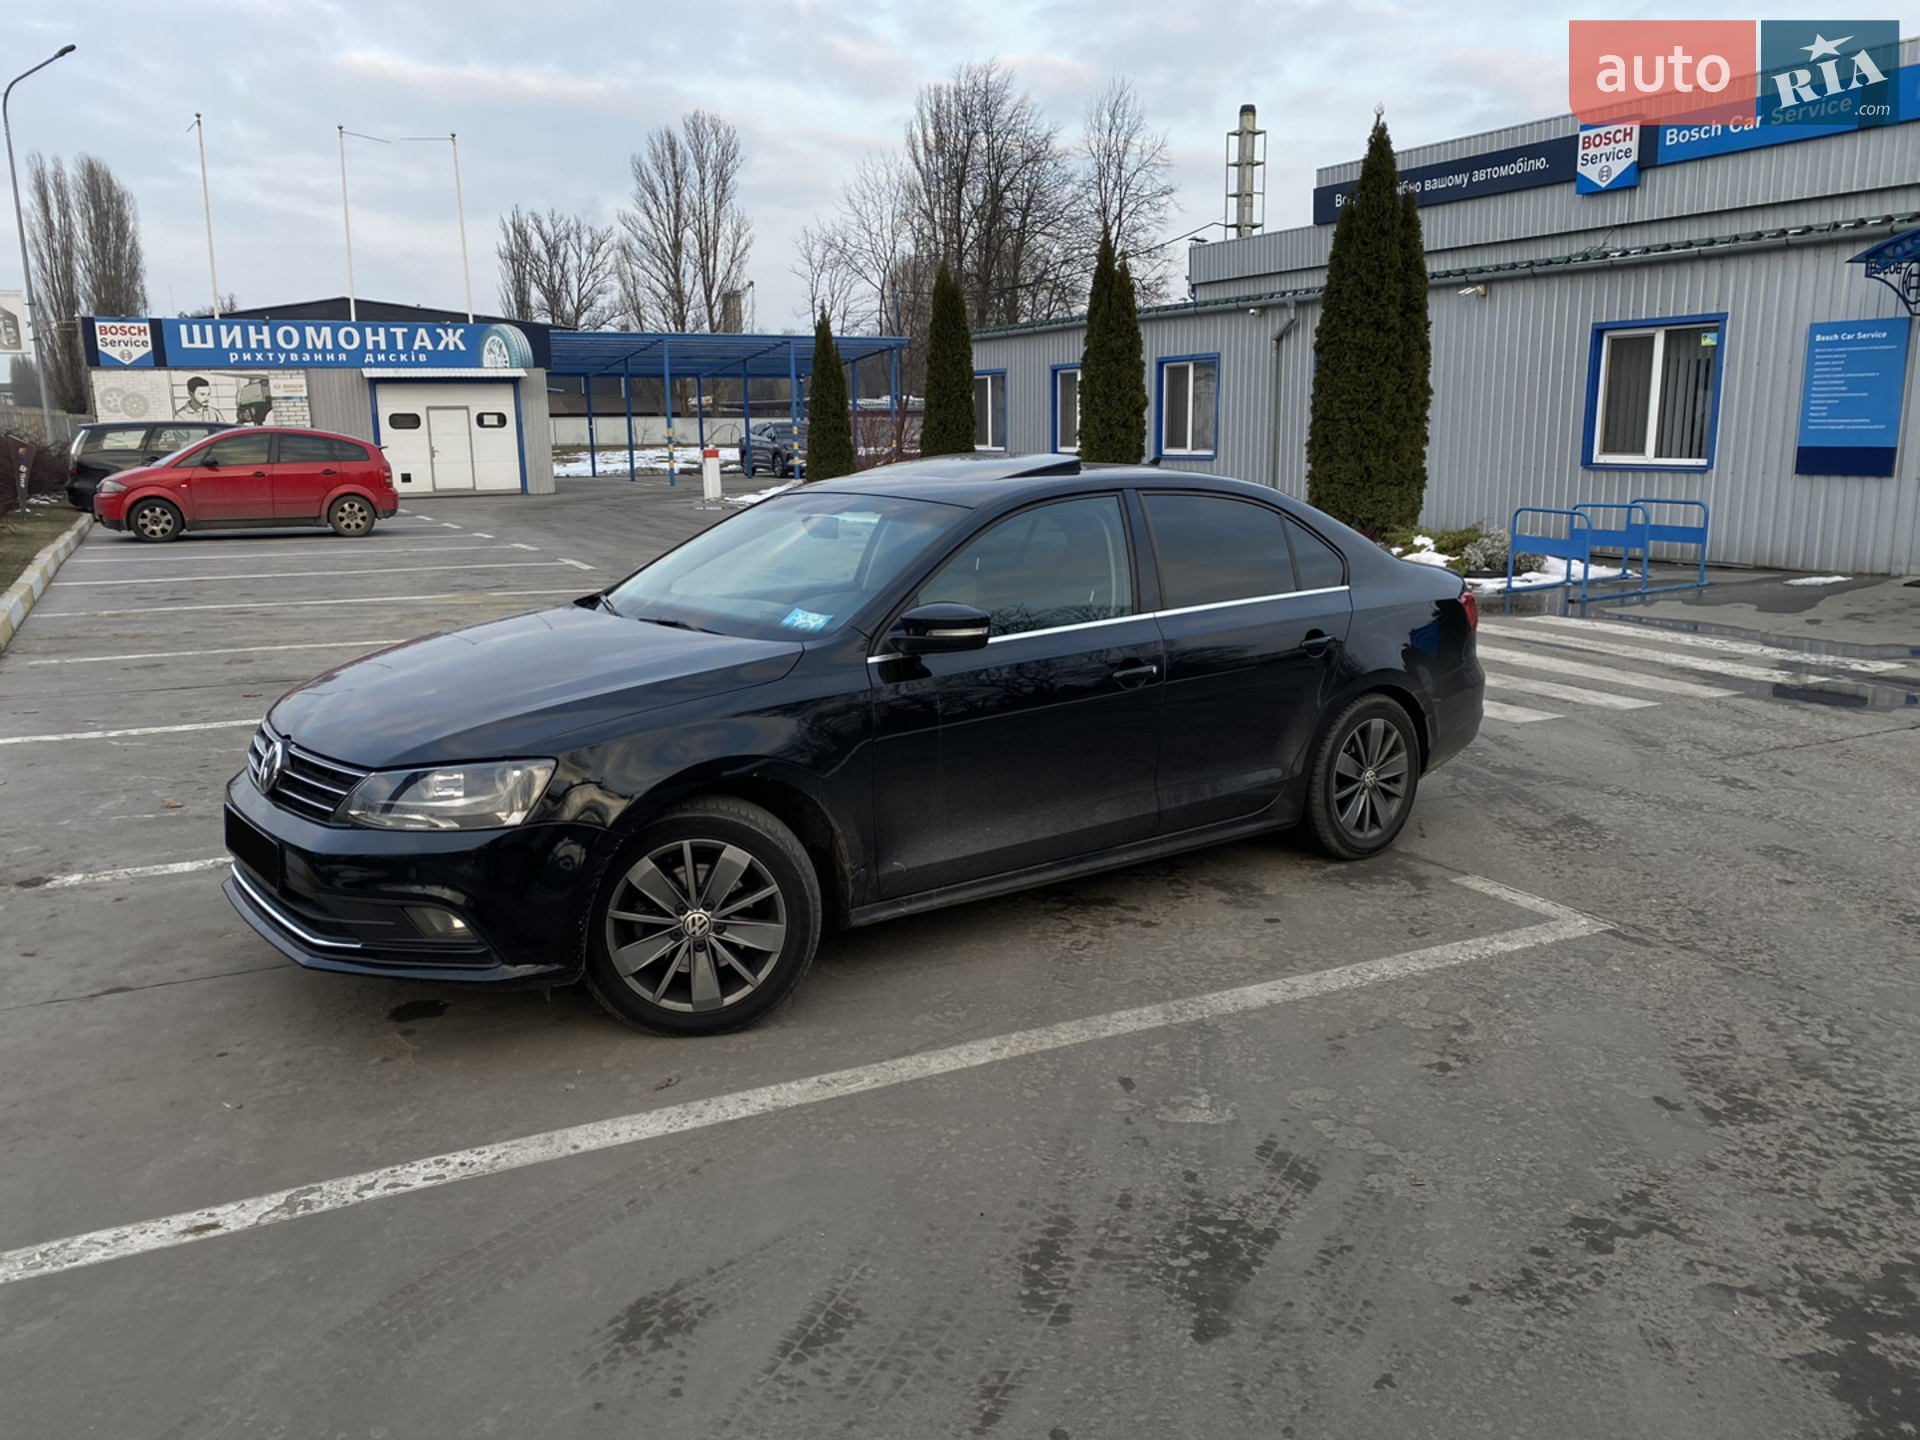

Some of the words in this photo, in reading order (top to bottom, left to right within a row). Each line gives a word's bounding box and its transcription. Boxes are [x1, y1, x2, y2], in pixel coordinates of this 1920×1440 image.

[1665, 118, 1722, 146] Bosch
[1729, 112, 1764, 133] Car
[1770, 97, 1852, 126] Service
[1582, 126, 1634, 151] BOSCH
[1580, 147, 1633, 167] Service
[1424, 172, 1469, 192] вашому
[1471, 156, 1550, 182] автомобілю.
[98, 325, 148, 336] BOSCH
[179, 324, 466, 351] ШИНОМОНТАЖ
[1815, 333, 1839, 342] Bosch
[1840, 332, 1855, 341] Car
[1857, 330, 1887, 340] Service
[100, 337, 149, 348] Service
[229, 351, 347, 363] рихтування
[364, 350, 427, 363] дисків
